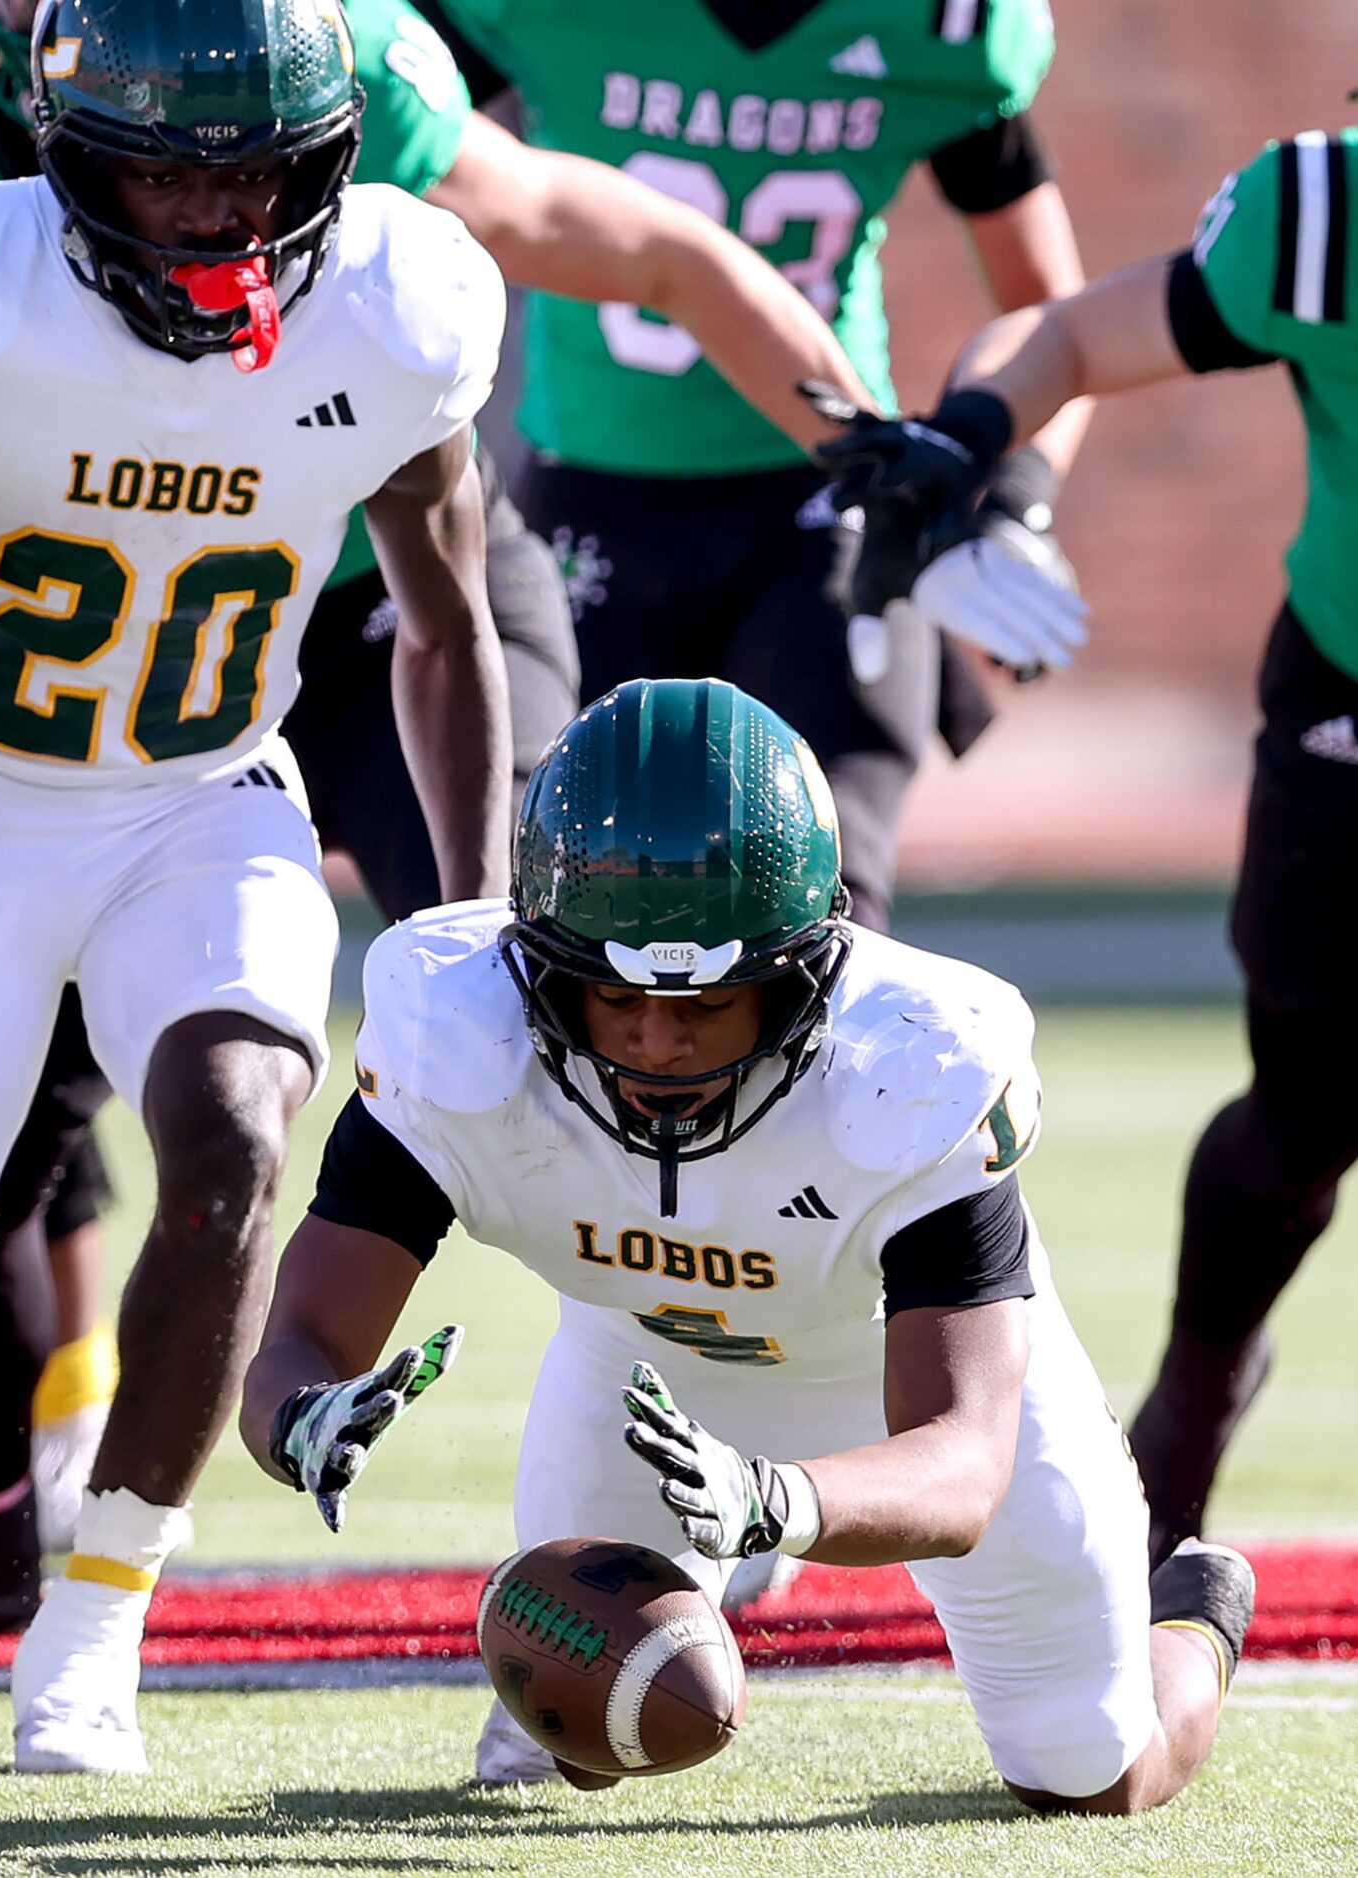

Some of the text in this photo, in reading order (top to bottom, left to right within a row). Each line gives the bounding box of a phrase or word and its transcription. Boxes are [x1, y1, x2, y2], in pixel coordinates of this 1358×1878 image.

[196, 124, 240, 139] VICIS
[600, 71, 885, 156] DRAGONS
[65, 451, 263, 516] LOBOS
[651, 948, 695, 961] VICIS
[573, 1219, 780, 1290] LOBOS
